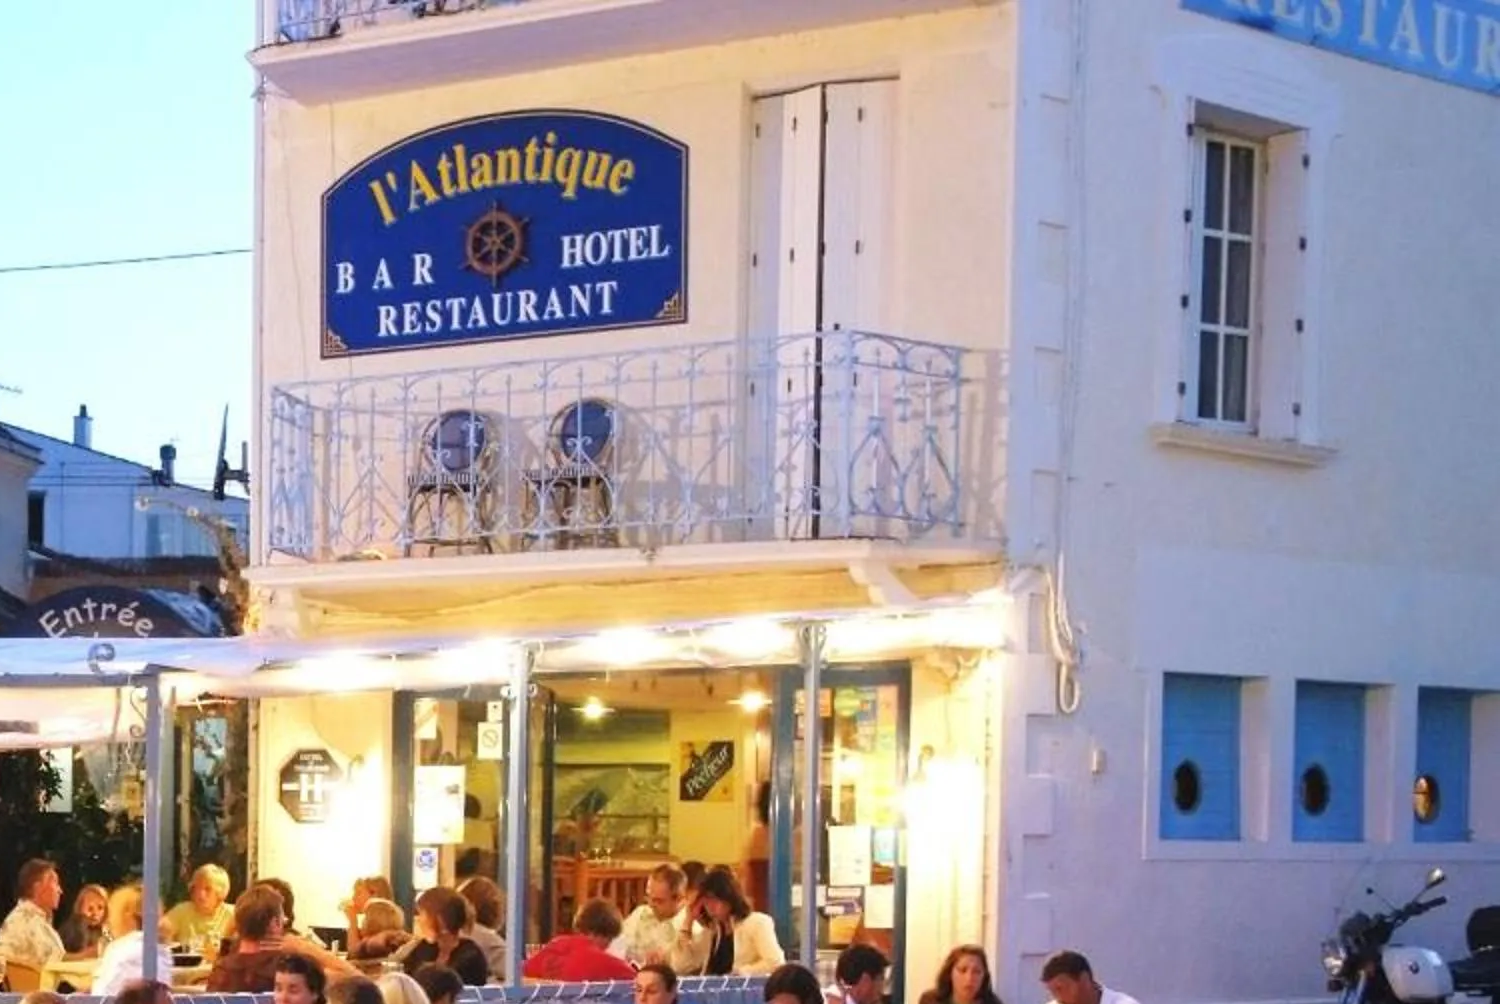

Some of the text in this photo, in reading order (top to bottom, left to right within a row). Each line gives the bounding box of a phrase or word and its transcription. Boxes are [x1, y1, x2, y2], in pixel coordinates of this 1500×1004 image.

[368, 131, 635, 226] l'Atlantique
[561, 224, 671, 269] HOTEL
[377, 281, 619, 338] RESTAURANT
[38, 597, 154, 638] Entrée
